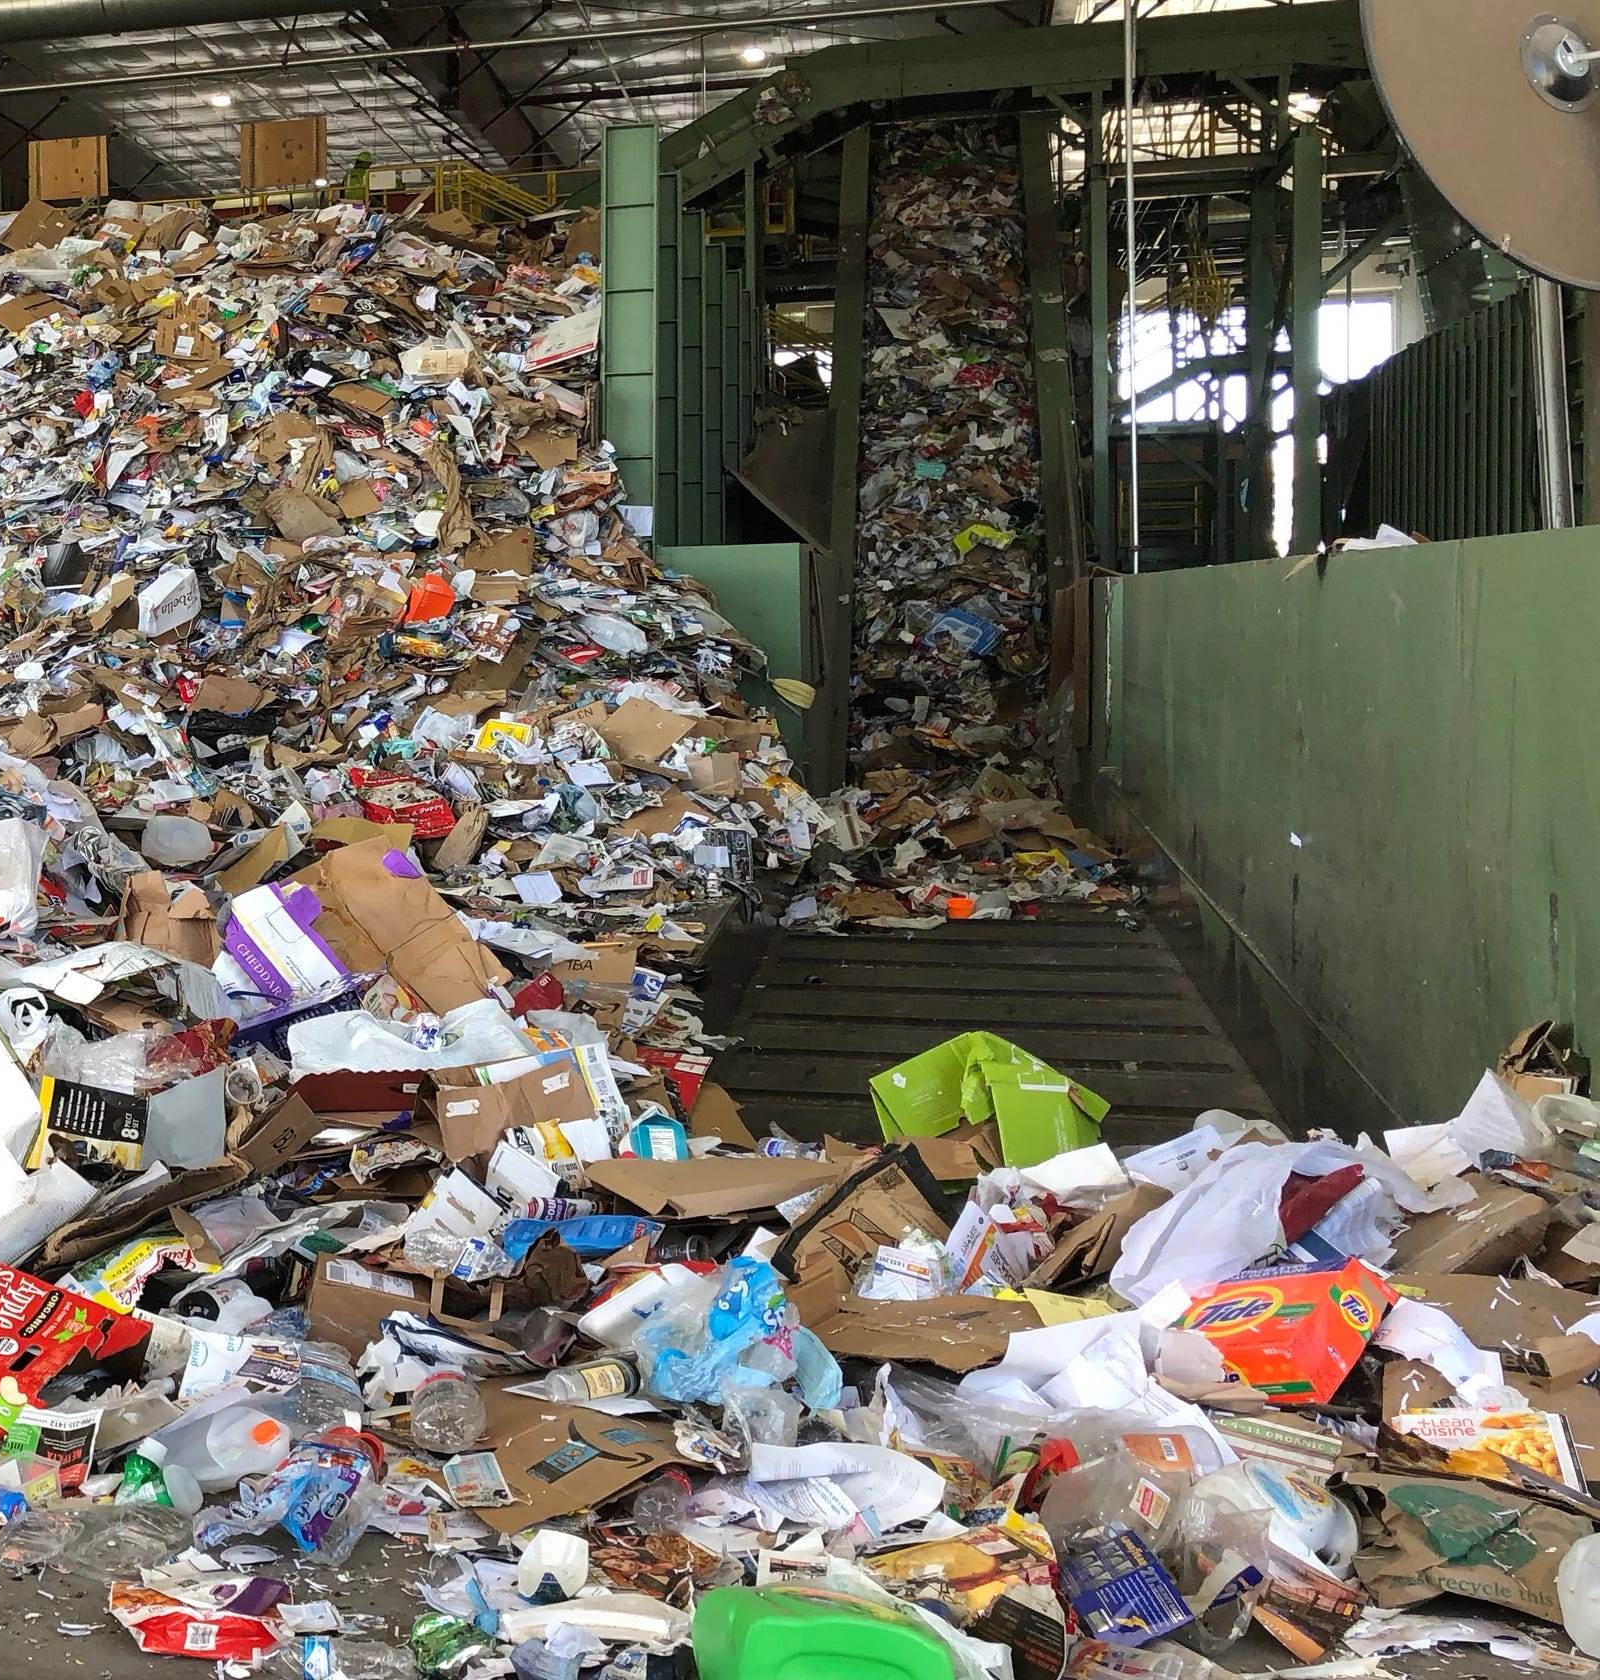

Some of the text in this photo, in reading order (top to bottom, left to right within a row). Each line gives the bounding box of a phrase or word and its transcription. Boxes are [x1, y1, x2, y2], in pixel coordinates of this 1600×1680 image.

[235, 942, 283, 998] CHEDDAR
[121, 1128, 140, 1141] 8
[515, 1130, 529, 1146] 24
[110, 1251, 143, 1280] SHANDY
[24, 1296, 60, 1334] ORGANIC
[1190, 1297, 1273, 1330] Tide
[1340, 1293, 1371, 1326] Tide
[190, 1340, 202, 1367] prime
[1410, 1424, 1476, 1437] cuisine
[1431, 1416, 1474, 1429] Lean
[1265, 1428, 1327, 1454] ORGANIC
[1437, 1575, 1513, 1599] recycle
[1517, 1588, 1554, 1608] this
